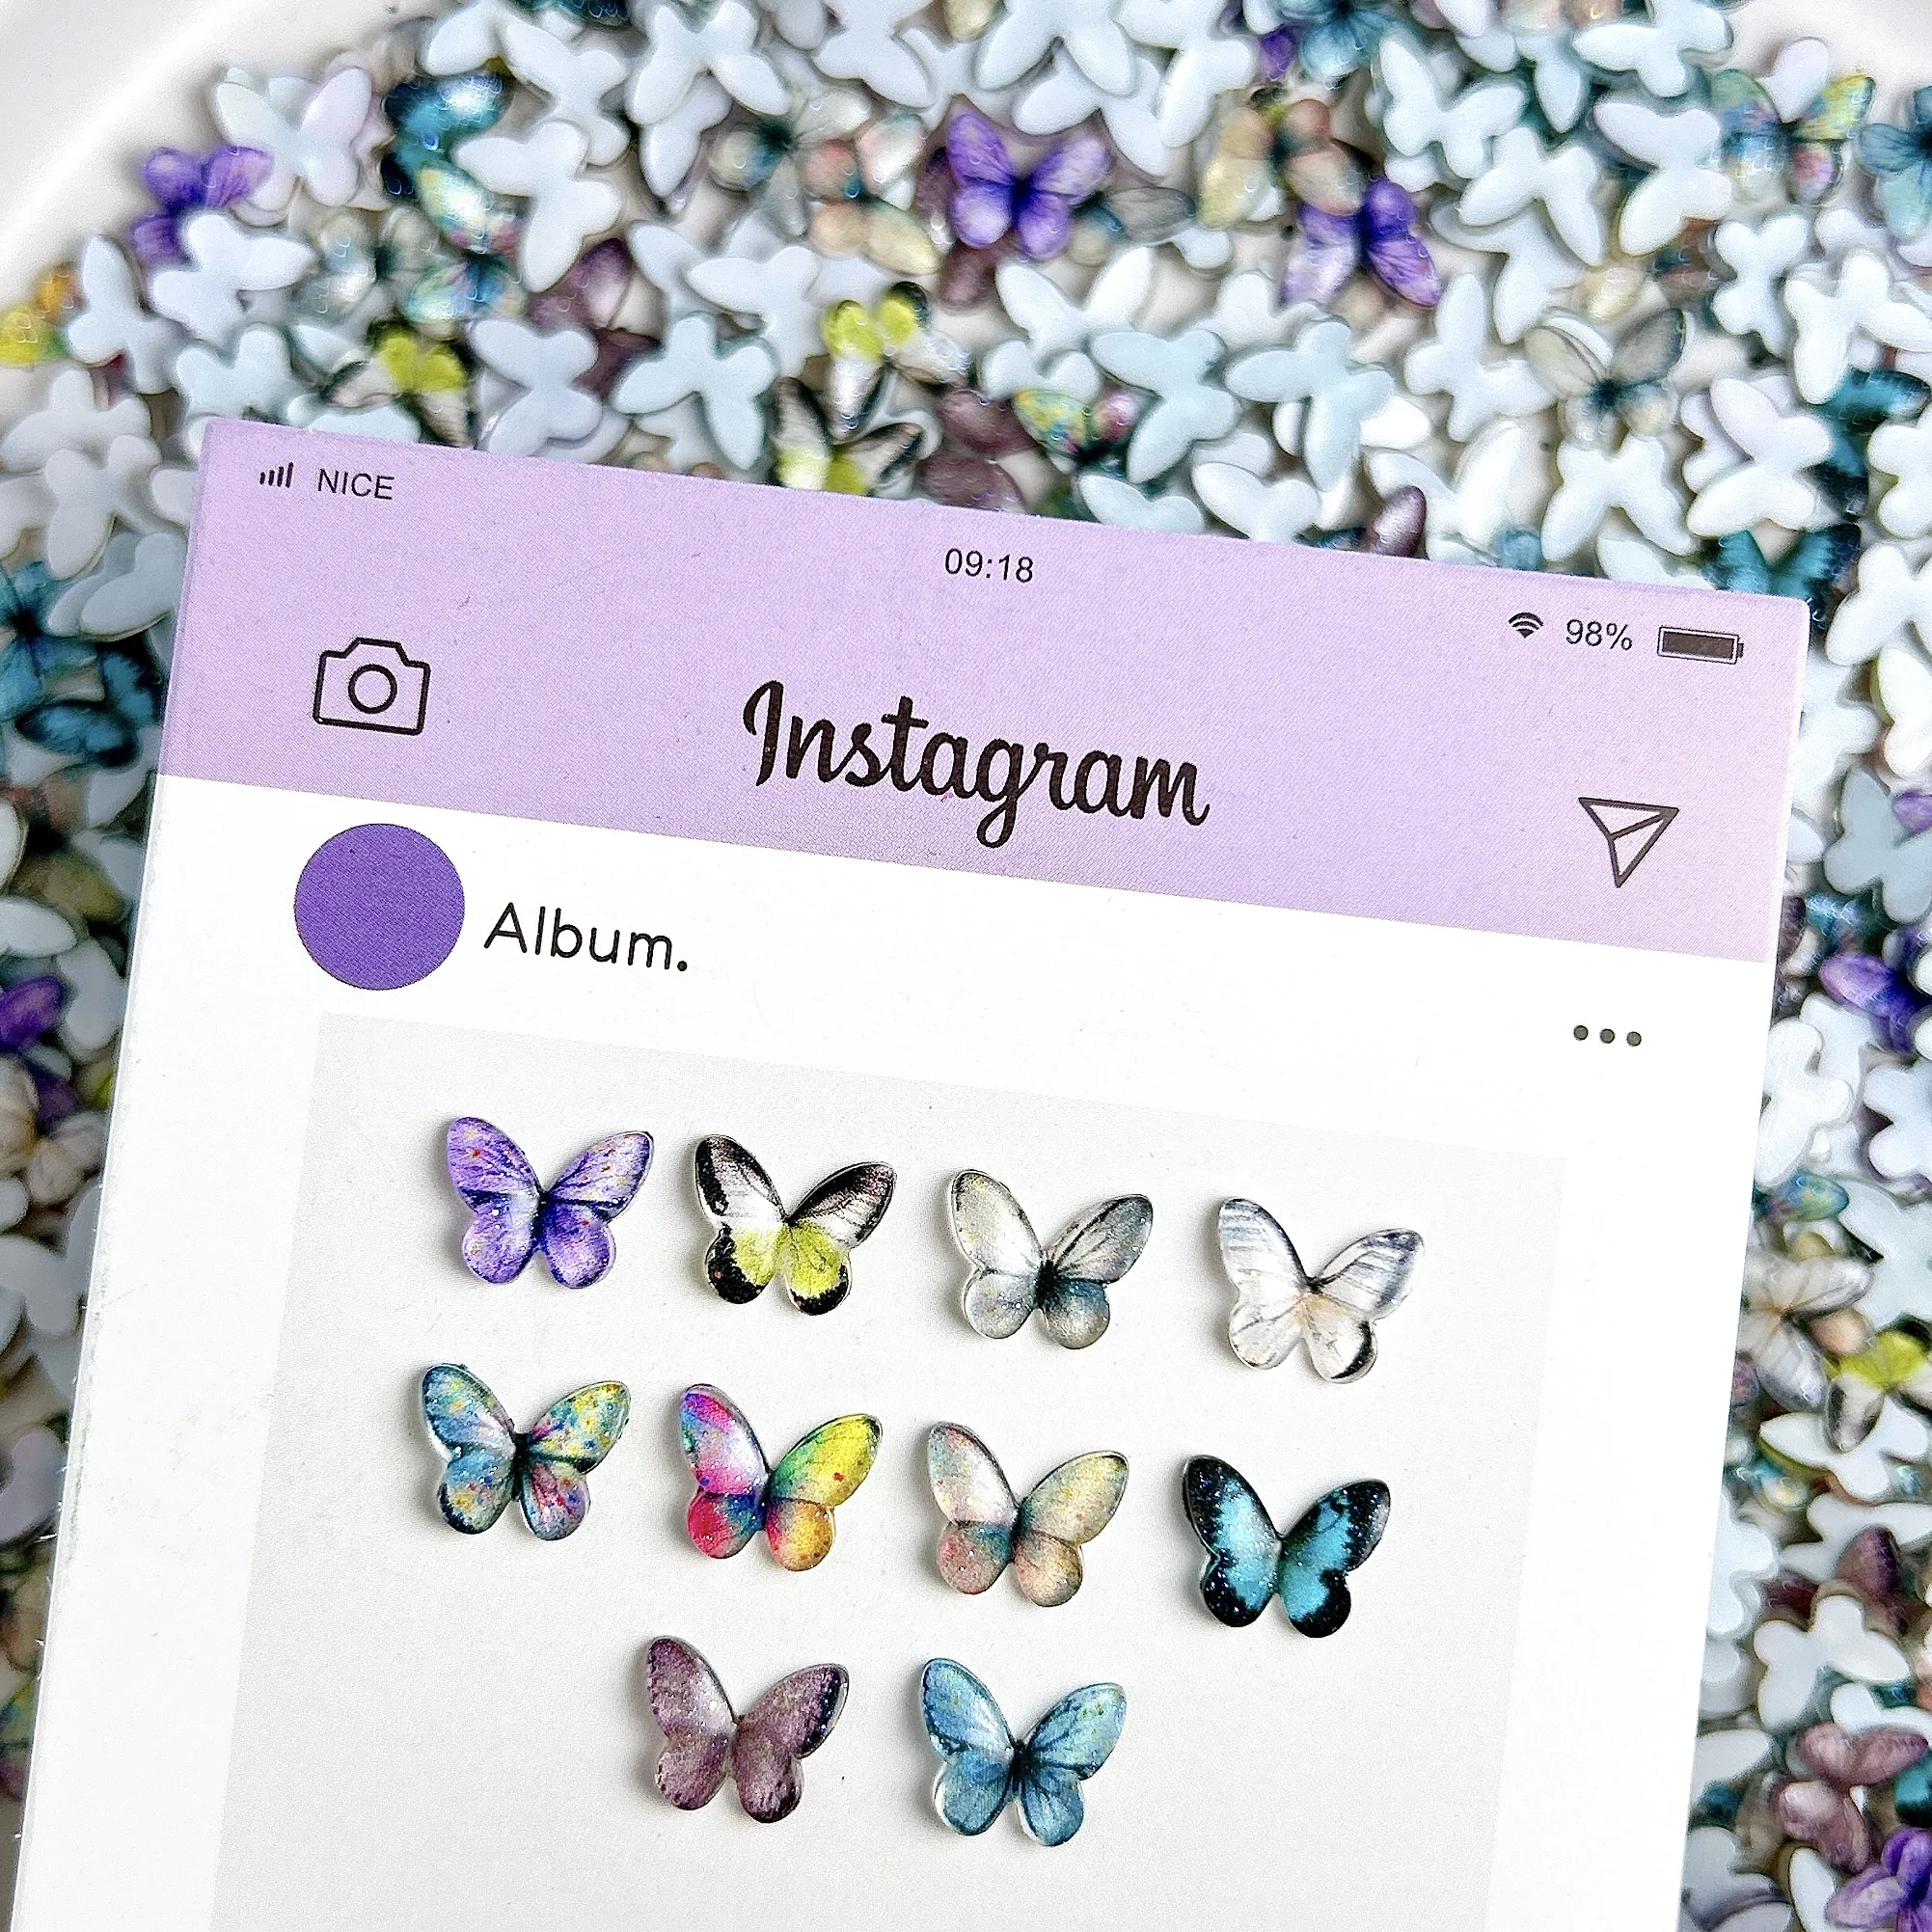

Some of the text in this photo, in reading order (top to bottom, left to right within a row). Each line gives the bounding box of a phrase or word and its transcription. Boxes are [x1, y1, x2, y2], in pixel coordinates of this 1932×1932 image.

[316, 467, 395, 502] NICE
[943, 547, 1035, 585] 09:18
[1565, 617, 1634, 651] 98%
[742, 679, 1211, 850] Instagram
[483, 902, 689, 973] Album.
